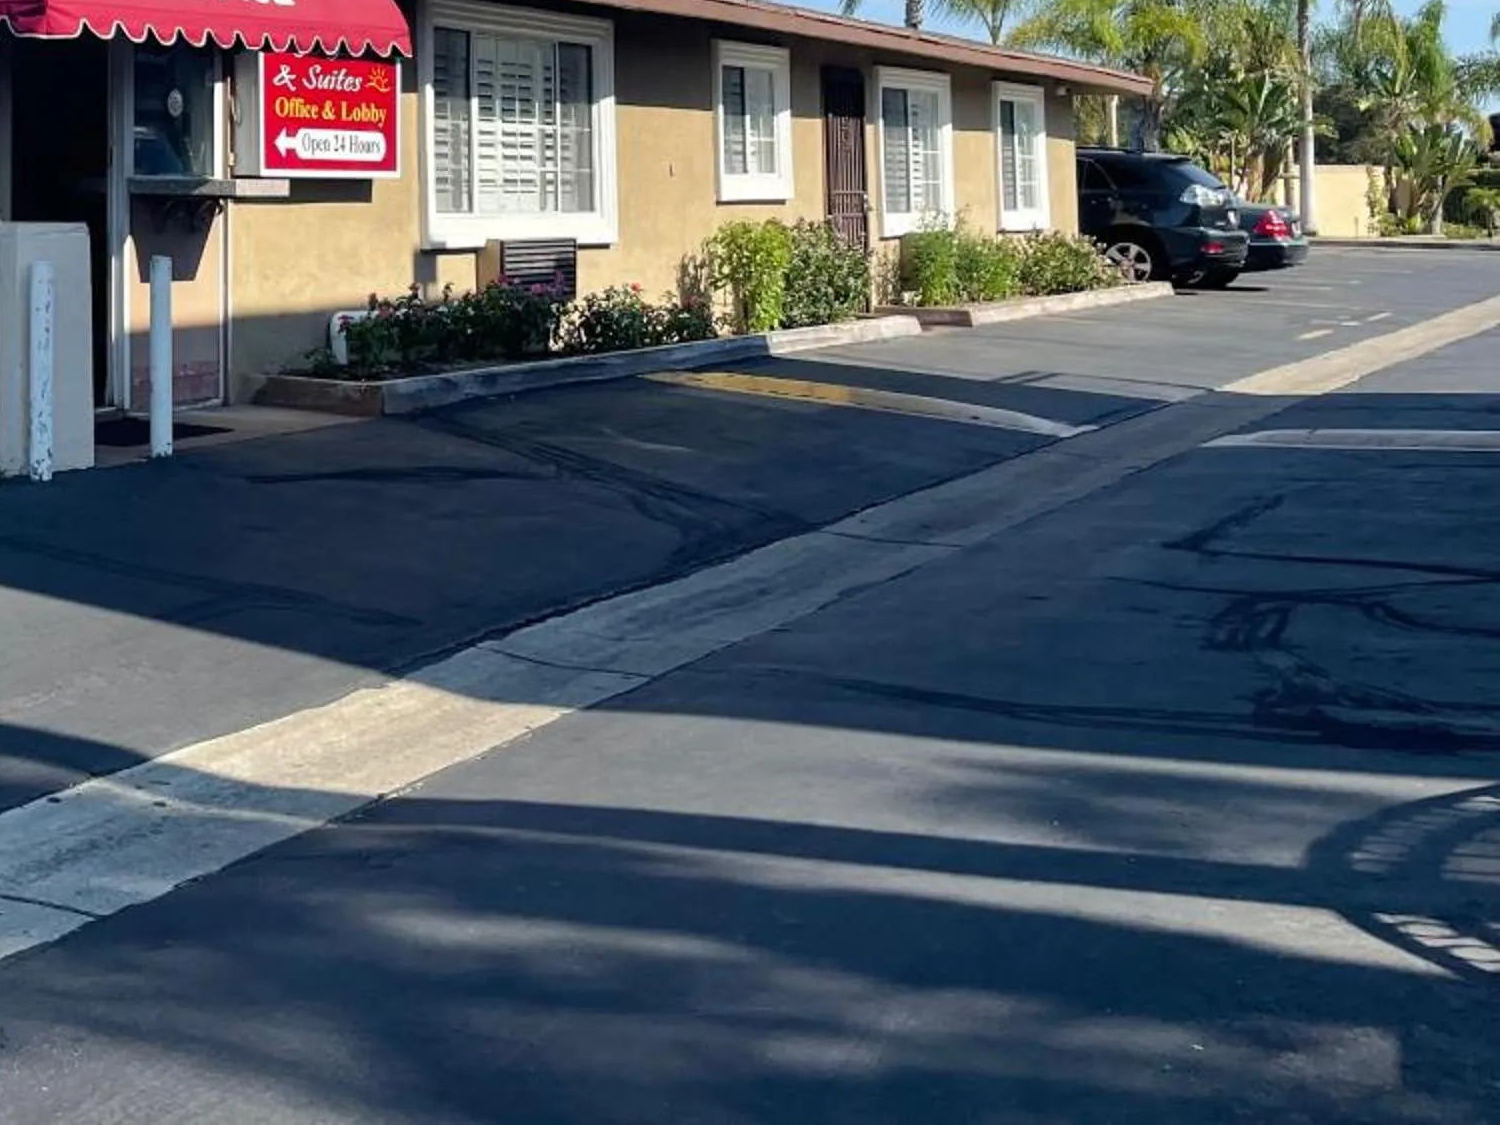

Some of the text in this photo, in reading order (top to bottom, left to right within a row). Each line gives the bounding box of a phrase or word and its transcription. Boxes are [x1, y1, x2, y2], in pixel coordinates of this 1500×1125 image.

[272, 64, 363, 92] & Suites
[274, 96, 386, 128] Office & Lobby
[301, 132, 381, 156] Open 24 Hours
